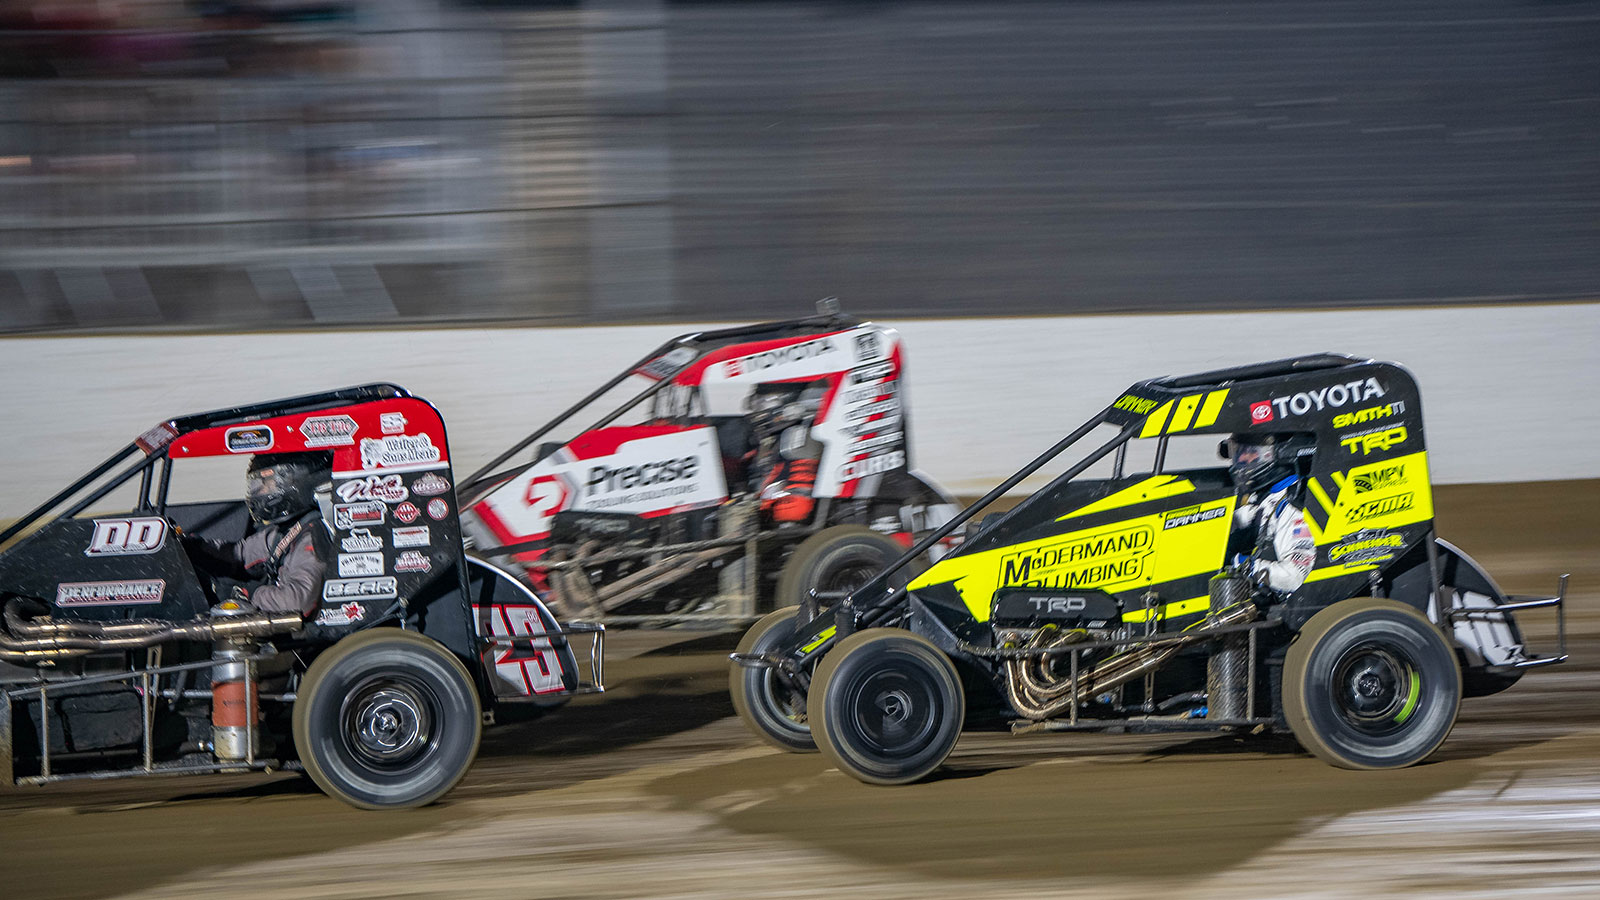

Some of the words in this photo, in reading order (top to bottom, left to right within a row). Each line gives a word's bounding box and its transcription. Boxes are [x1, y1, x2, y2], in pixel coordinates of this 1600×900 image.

[742, 338, 836, 371] TOYOTA
[1272, 376, 1386, 419] TOYOTA
[1340, 426, 1409, 456] TRD
[586, 454, 699, 497] Precise
[1028, 596, 1086, 613] TRD
